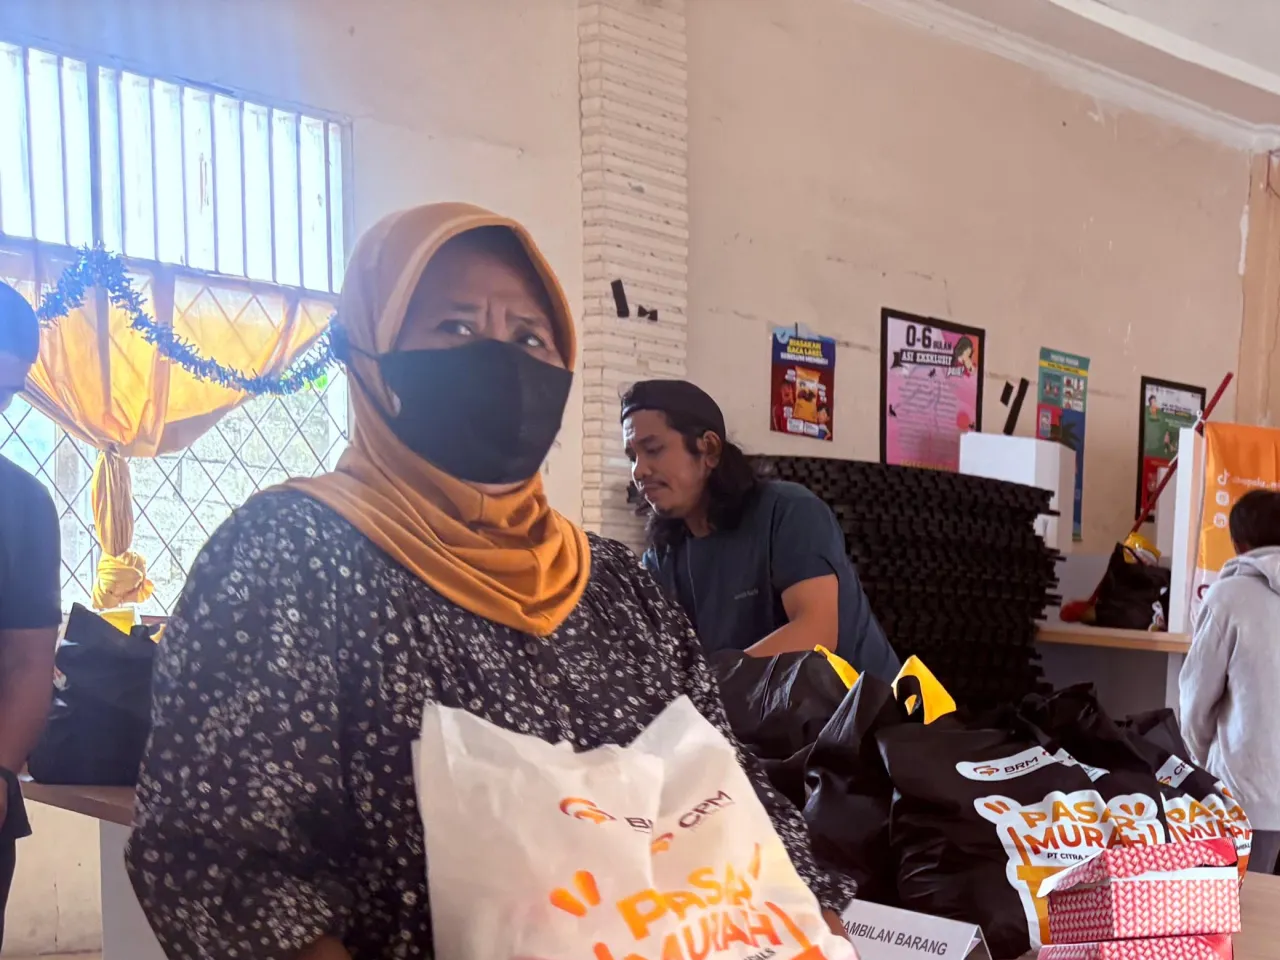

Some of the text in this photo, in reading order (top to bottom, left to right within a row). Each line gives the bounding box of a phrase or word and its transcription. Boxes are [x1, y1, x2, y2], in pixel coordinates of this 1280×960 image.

[906, 325, 932, 349] 0-6
[902, 351, 952, 365] ASI EKSKLUSIF
[1004, 756, 1039, 773] BRM
[679, 790, 735, 828] CPM
[1060, 853, 1084, 861] CITRA
[841, 919, 948, 956] AMBILAN BARANG
